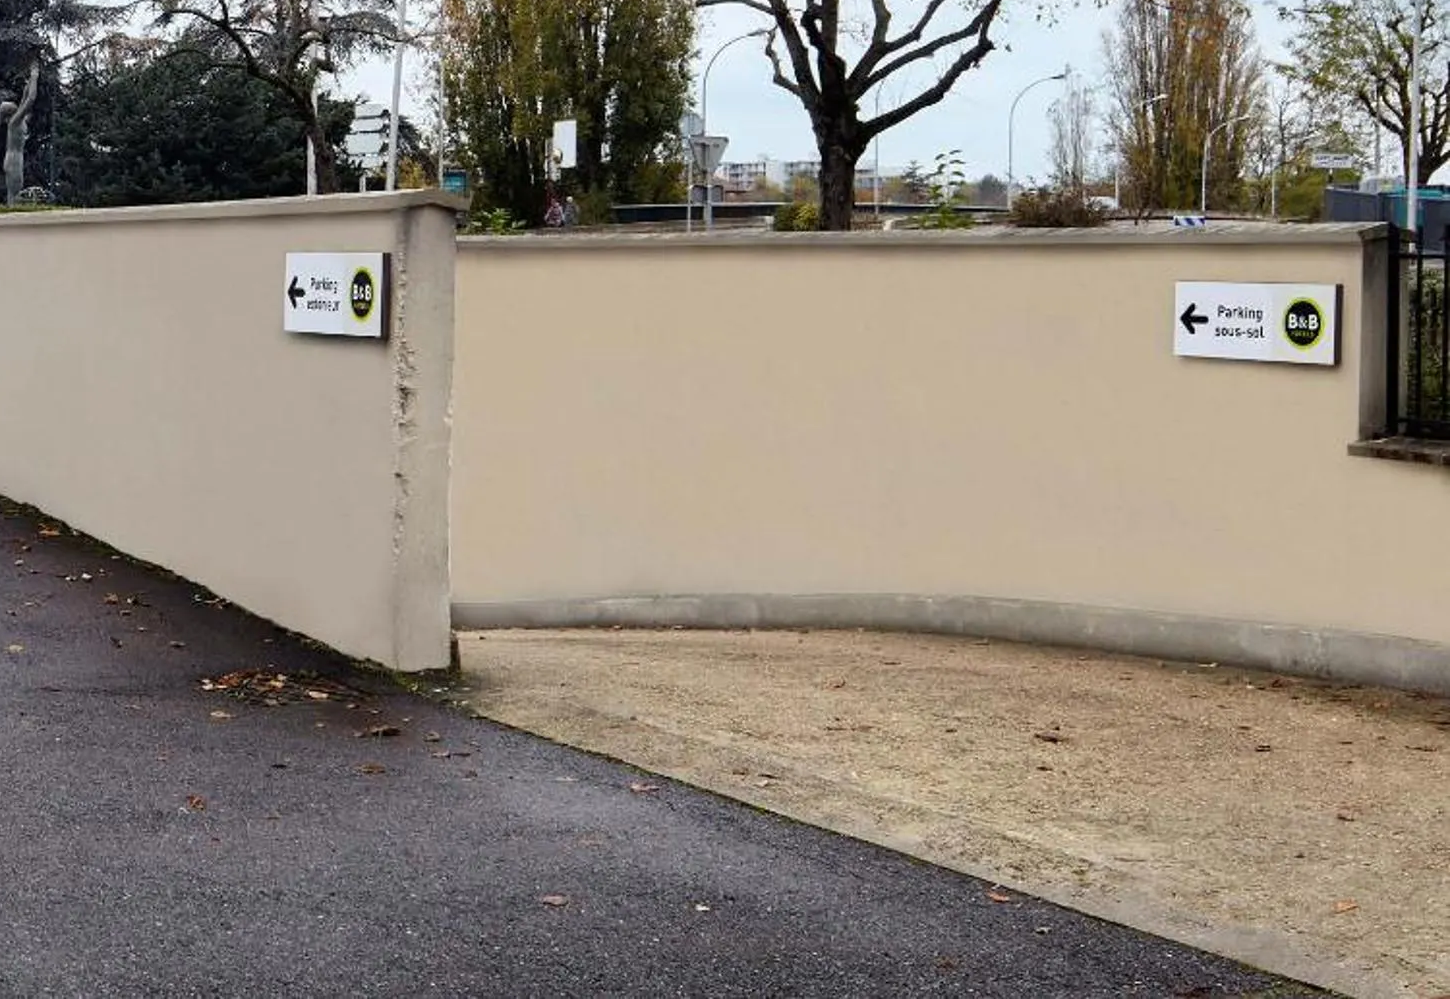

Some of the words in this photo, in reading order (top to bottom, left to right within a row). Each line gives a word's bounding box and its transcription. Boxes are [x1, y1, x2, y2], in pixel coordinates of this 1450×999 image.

[1217, 305, 1263, 322] Parking
[1289, 313, 1319, 330] B&B
[1215, 326, 1265, 339] sous-sol
